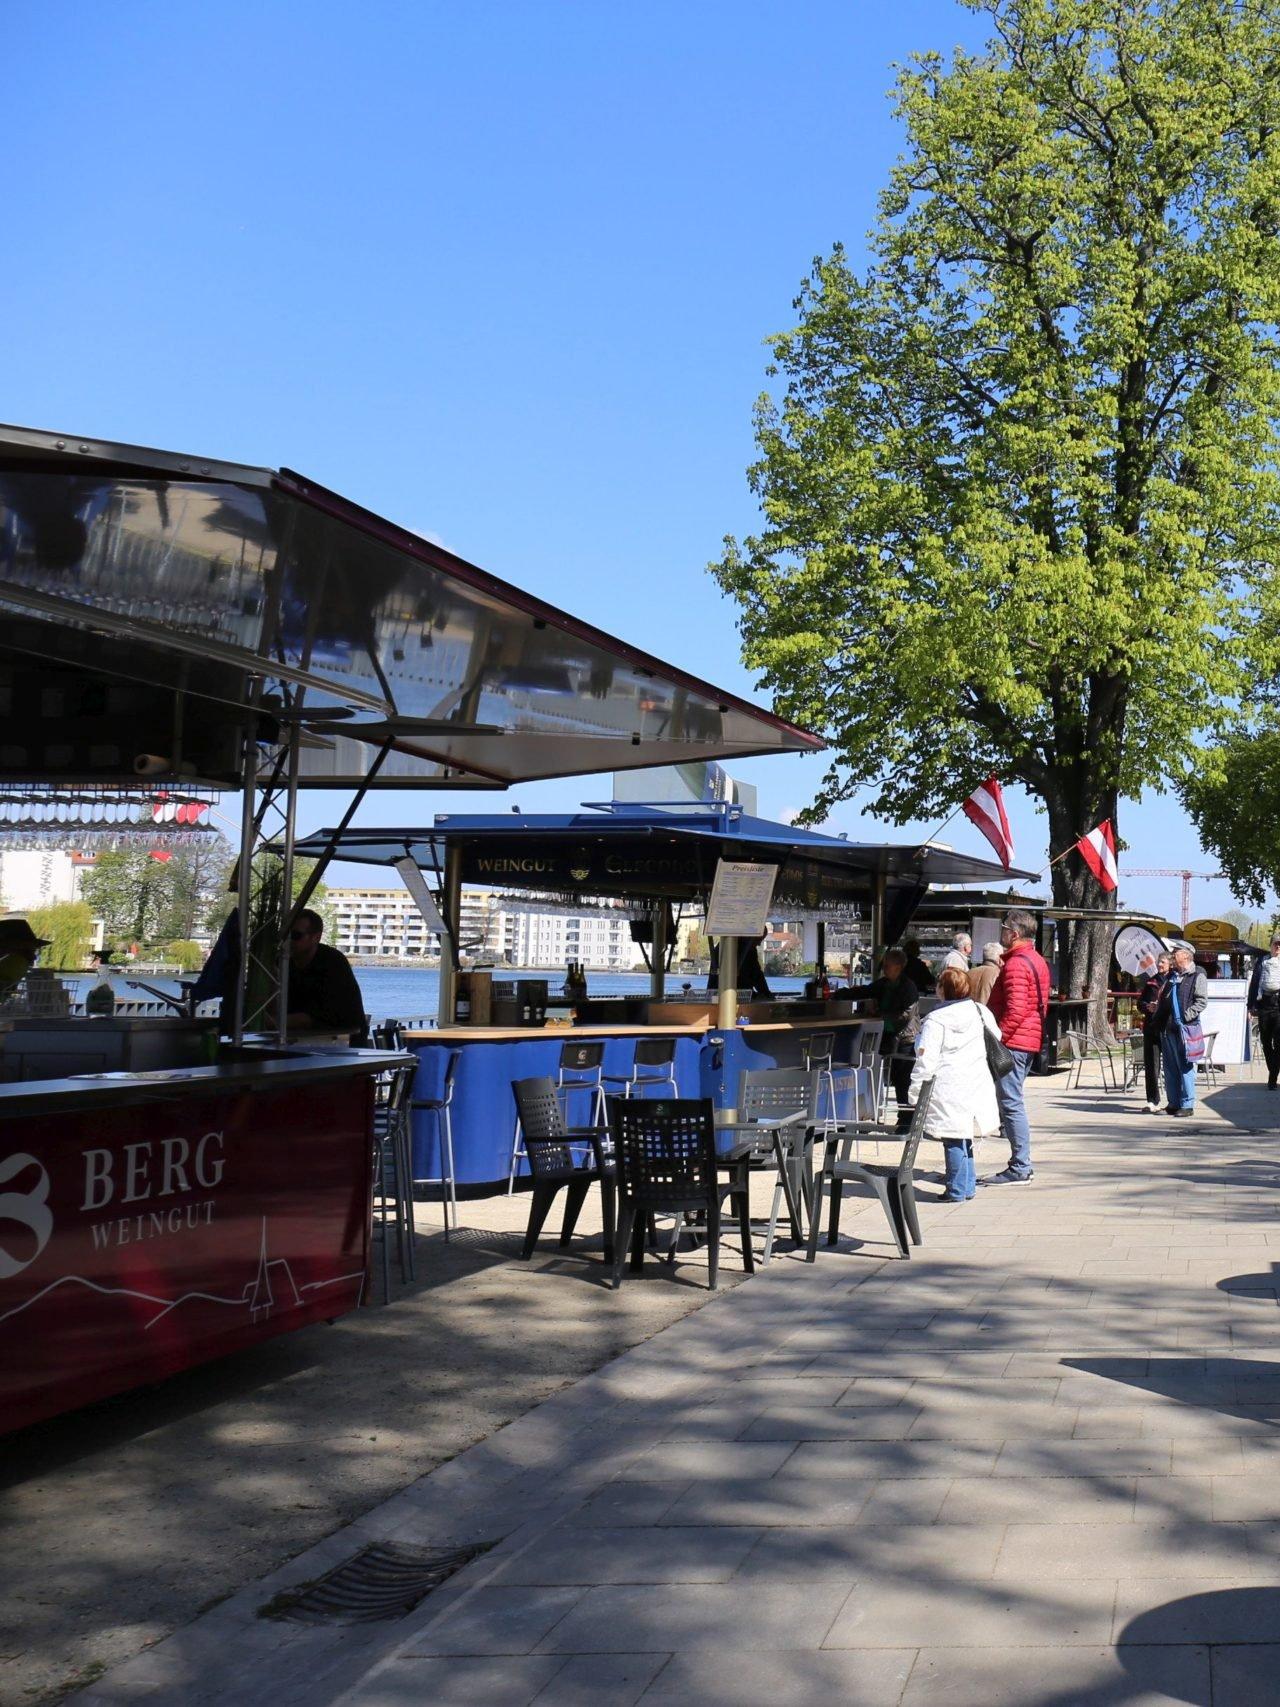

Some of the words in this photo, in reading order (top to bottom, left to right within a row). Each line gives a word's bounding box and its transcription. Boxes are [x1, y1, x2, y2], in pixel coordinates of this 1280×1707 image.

[477, 858, 556, 873] WEINGUT
[79, 1130, 227, 1211] BERG
[91, 1200, 216, 1251] WEINGUT
